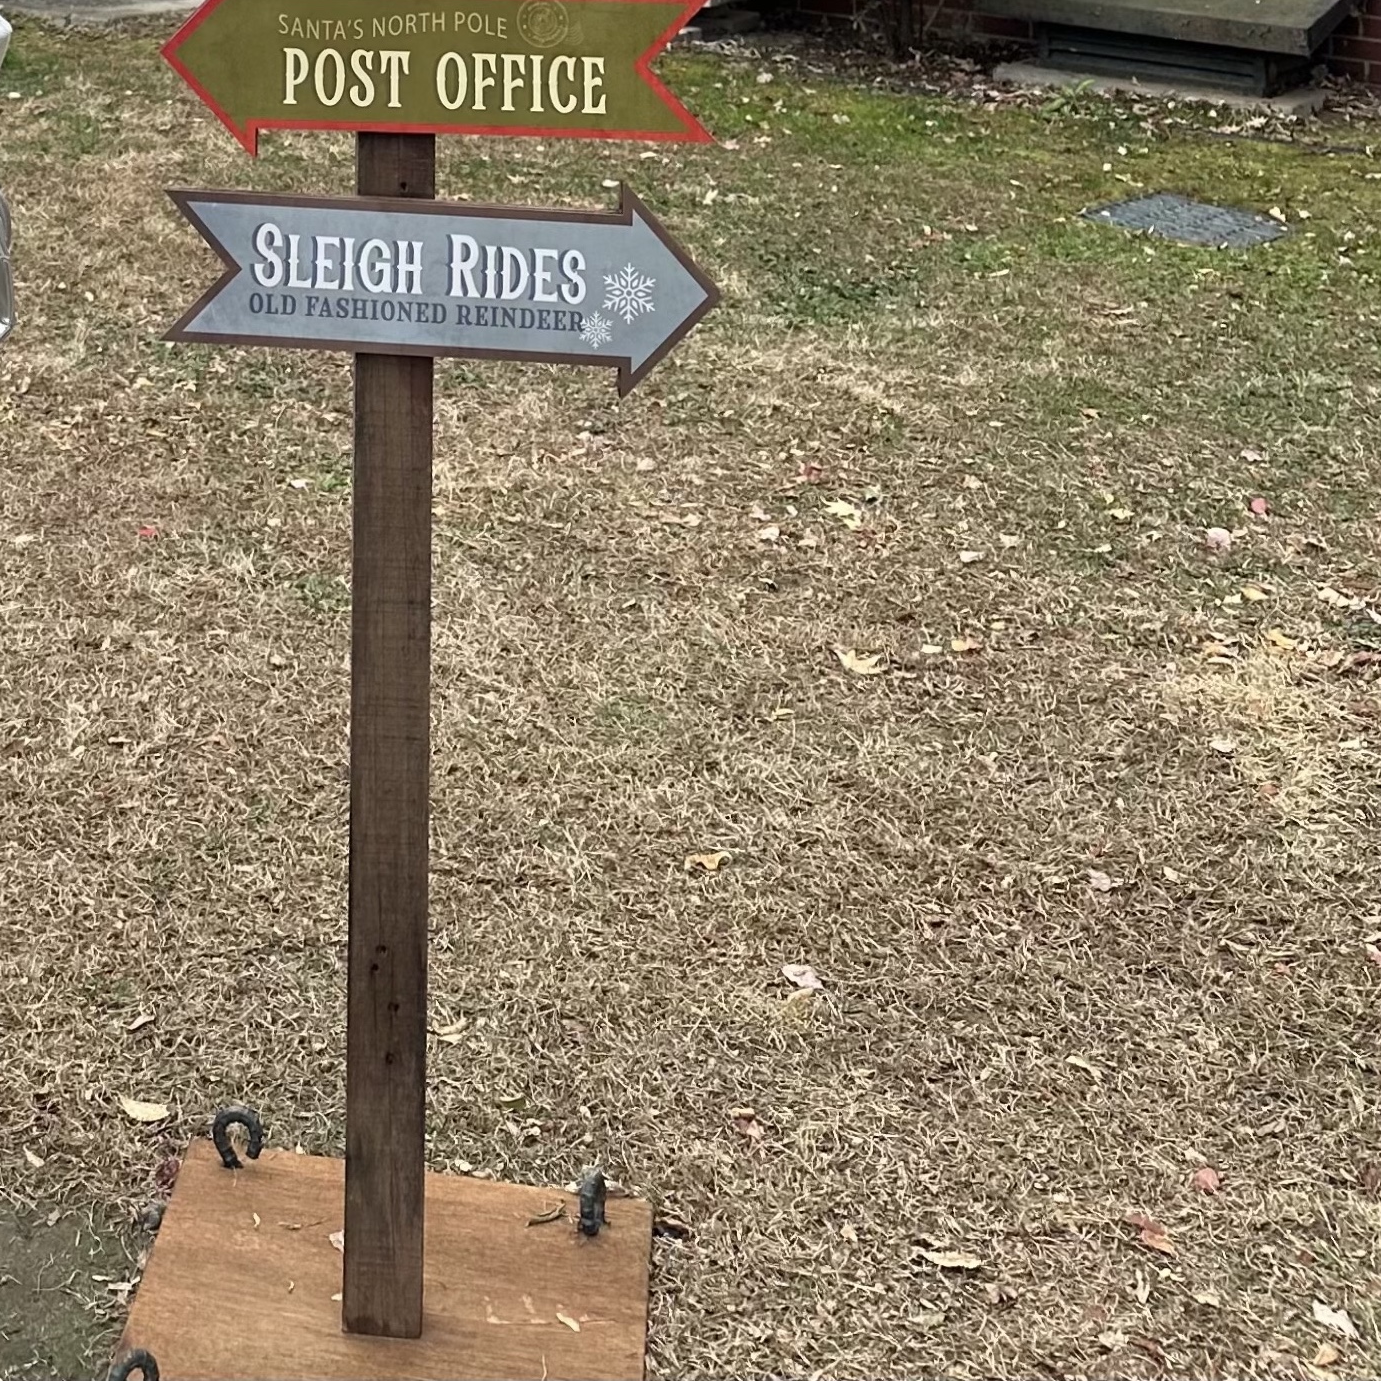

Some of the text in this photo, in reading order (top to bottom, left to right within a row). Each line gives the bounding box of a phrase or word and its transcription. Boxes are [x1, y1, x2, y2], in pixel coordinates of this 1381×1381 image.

[278, 12, 508, 41] SANTA'S NORTH POLE
[282, 48, 607, 115] POST OFFICE
[251, 222, 588, 305] SLEIGH RIDES
[248, 292, 585, 333] OLD FASHIONED REINDEER
